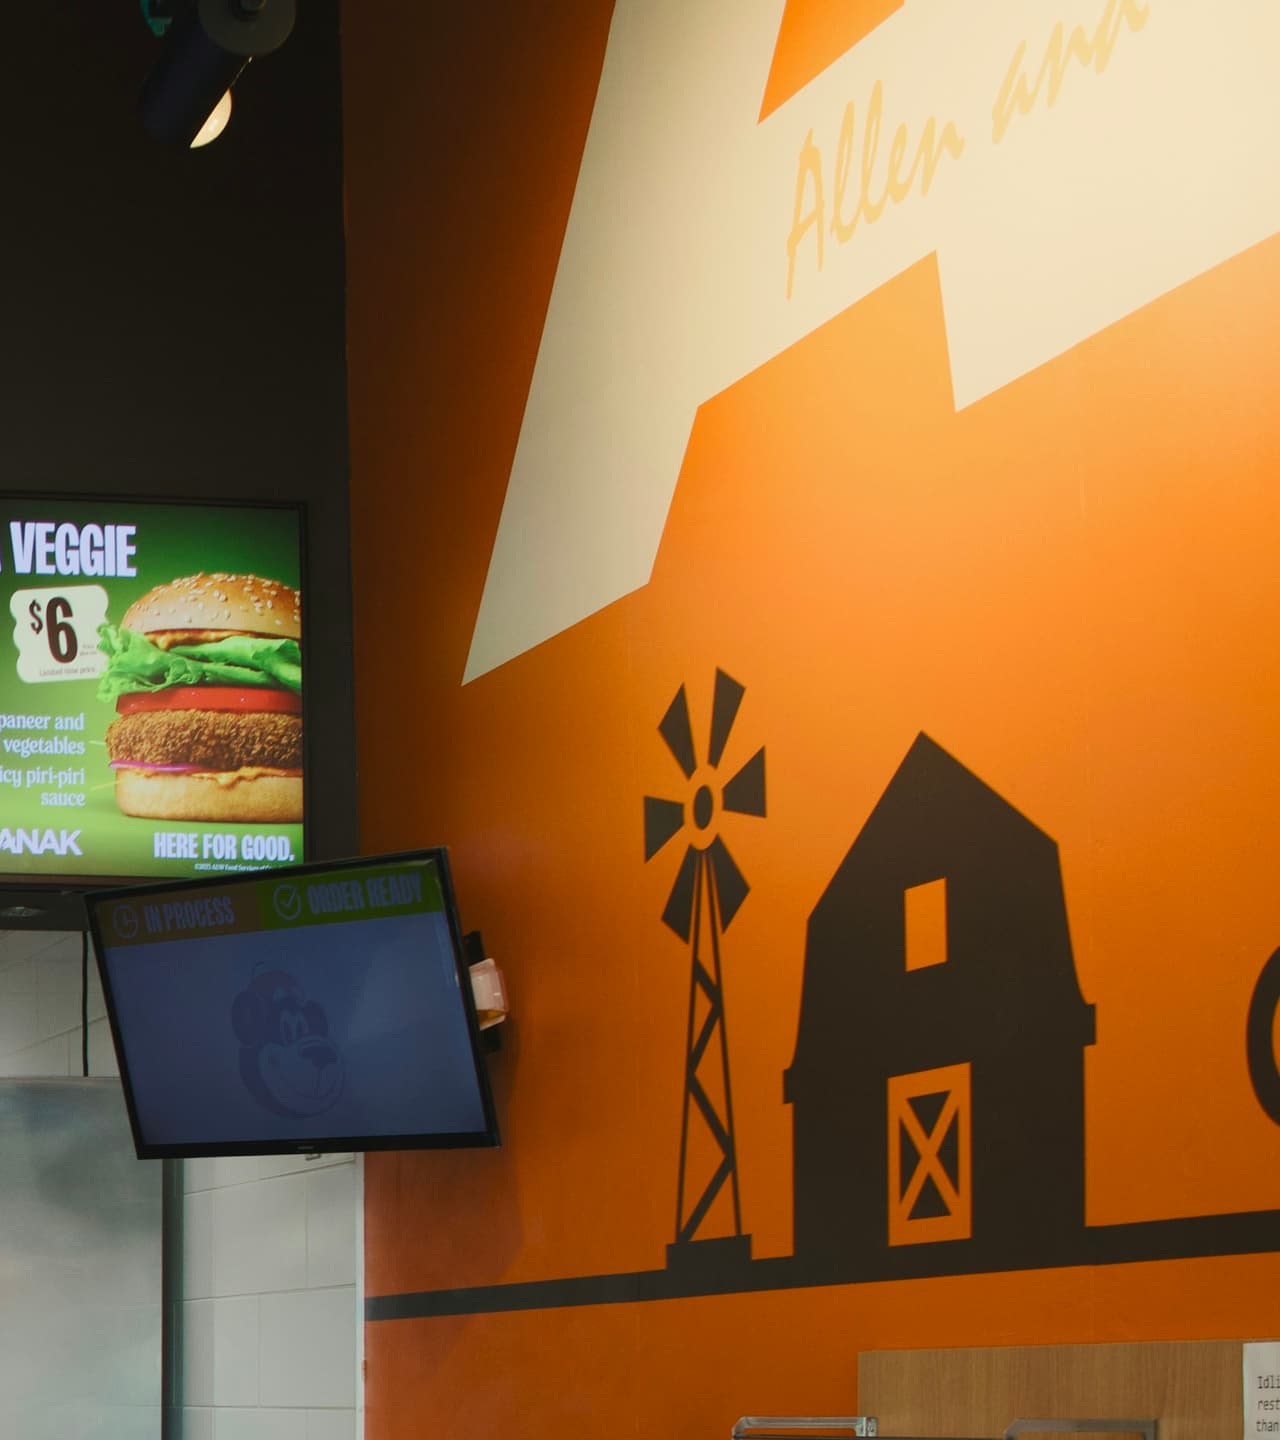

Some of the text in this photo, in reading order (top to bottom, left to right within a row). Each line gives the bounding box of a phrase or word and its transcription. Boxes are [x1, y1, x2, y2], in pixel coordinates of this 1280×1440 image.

[787, 79, 965, 301] Allen
[10, 521, 136, 577] VEGGIE
[28, 596, 78, 664] $6
[55, 712, 84, 731] and
[4, 736, 86, 758] vegetables
[26, 765, 85, 787] piri-piri
[41, 791, 86, 807] sauce
[155, 833, 295, 862] HERE FOR GOOD.
[307, 874, 422, 915] ORDER READY
[145, 897, 235, 933] IN PROCESS
